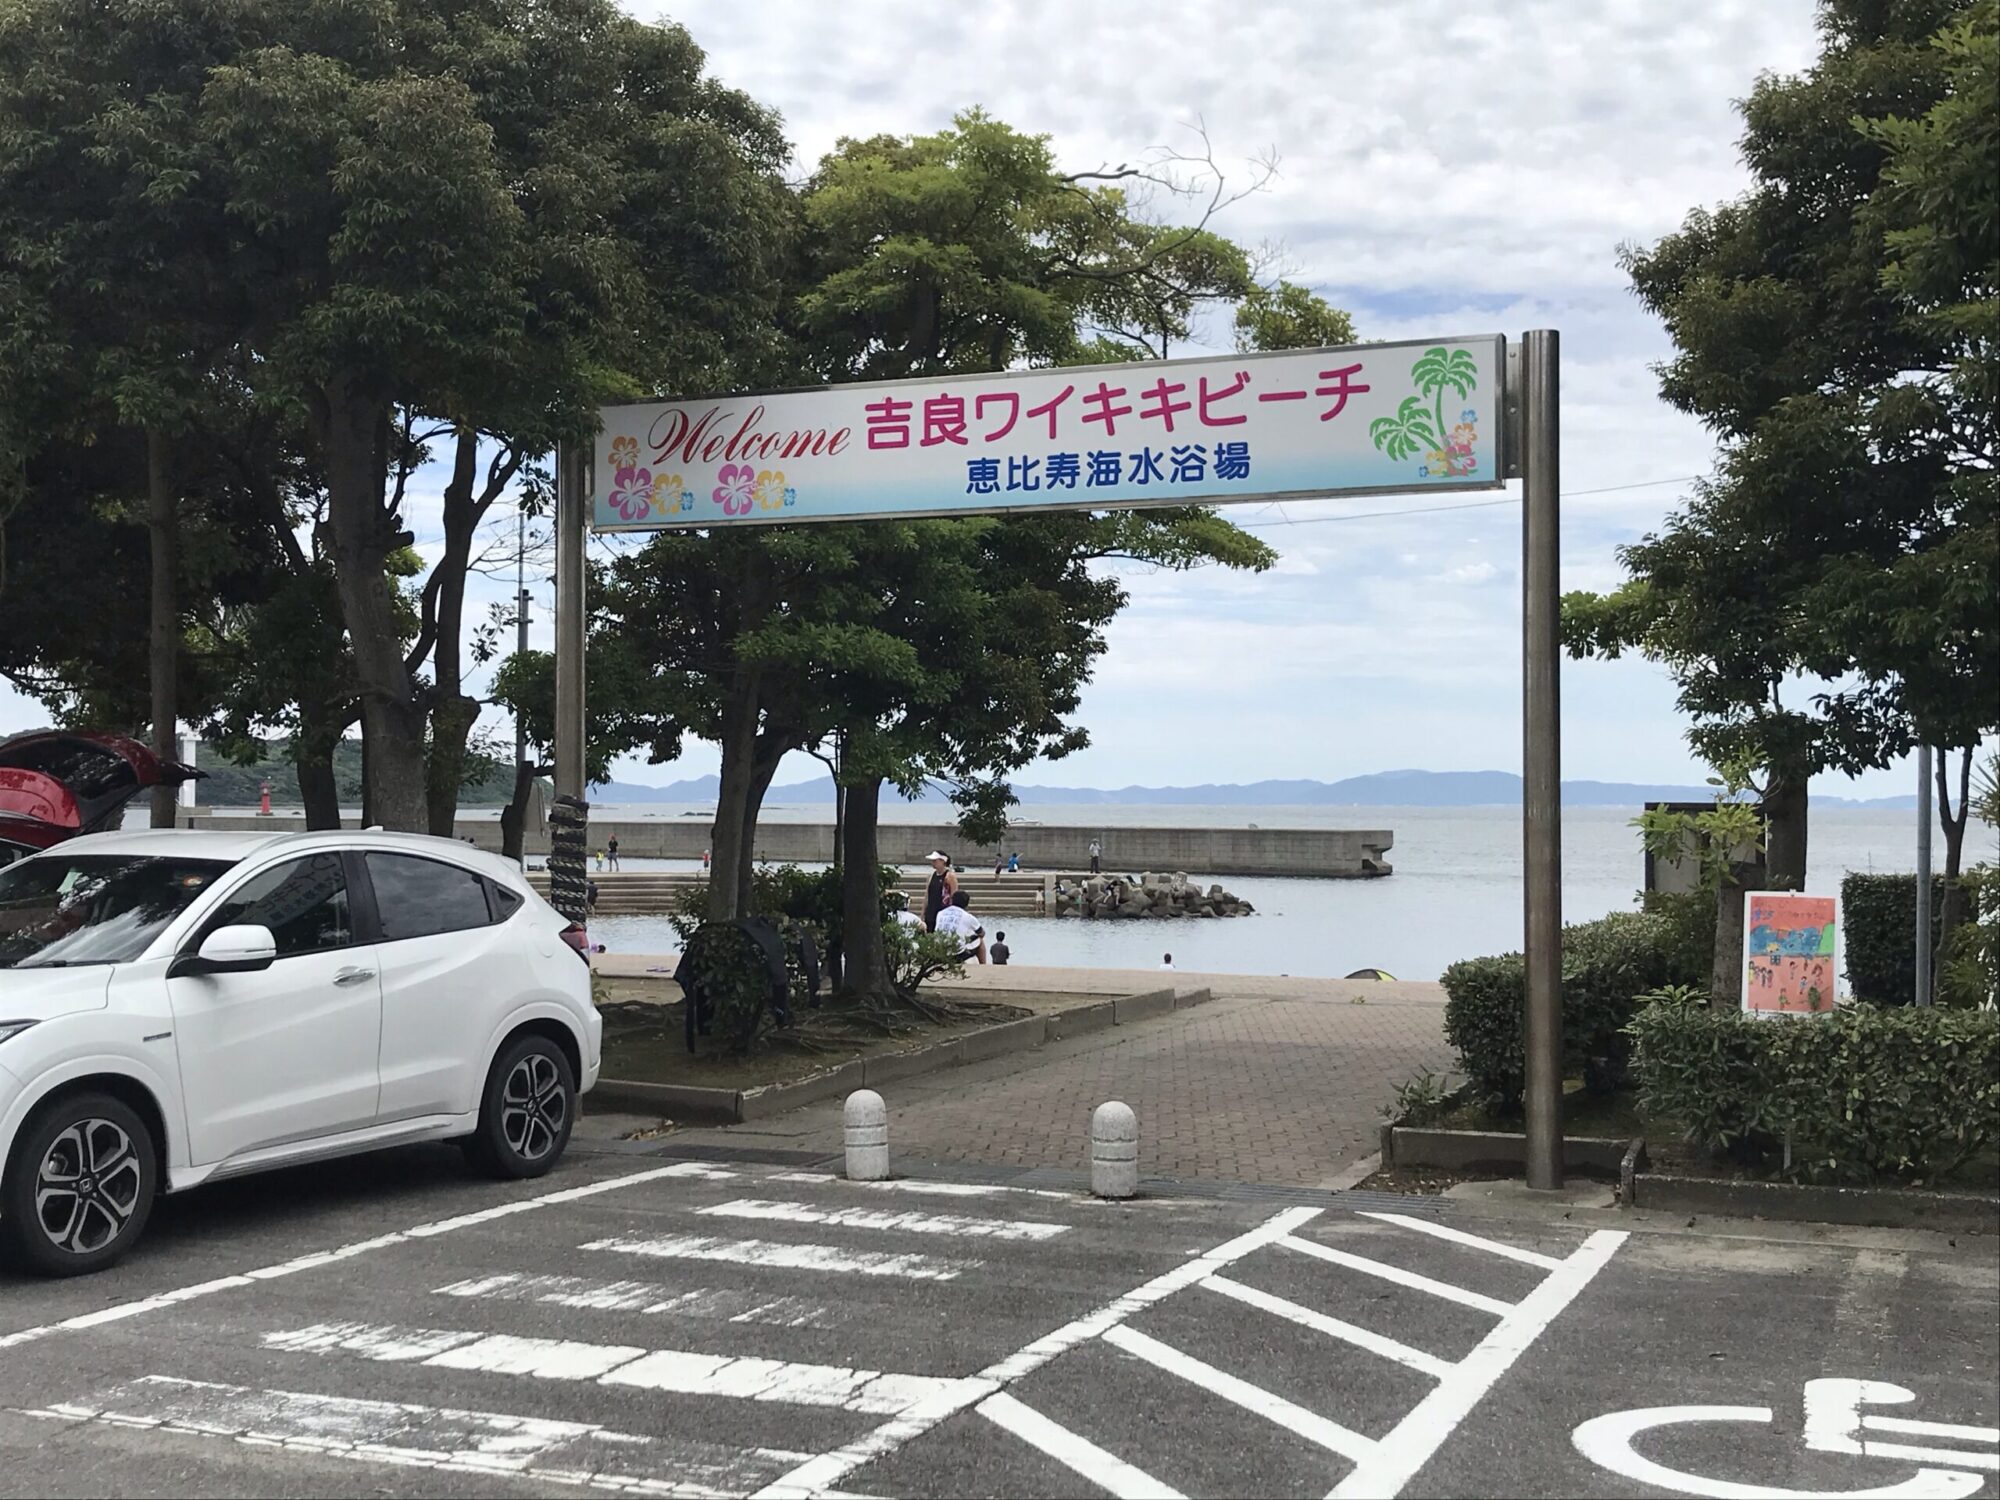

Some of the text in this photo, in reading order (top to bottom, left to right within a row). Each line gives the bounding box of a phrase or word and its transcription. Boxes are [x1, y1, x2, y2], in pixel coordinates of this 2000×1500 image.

[648, 405, 851, 465] Welcome
[865, 364, 1369, 449] 吉良ワイキキビーチ
[966, 442, 1250, 494] 恵比寿海水浴場
